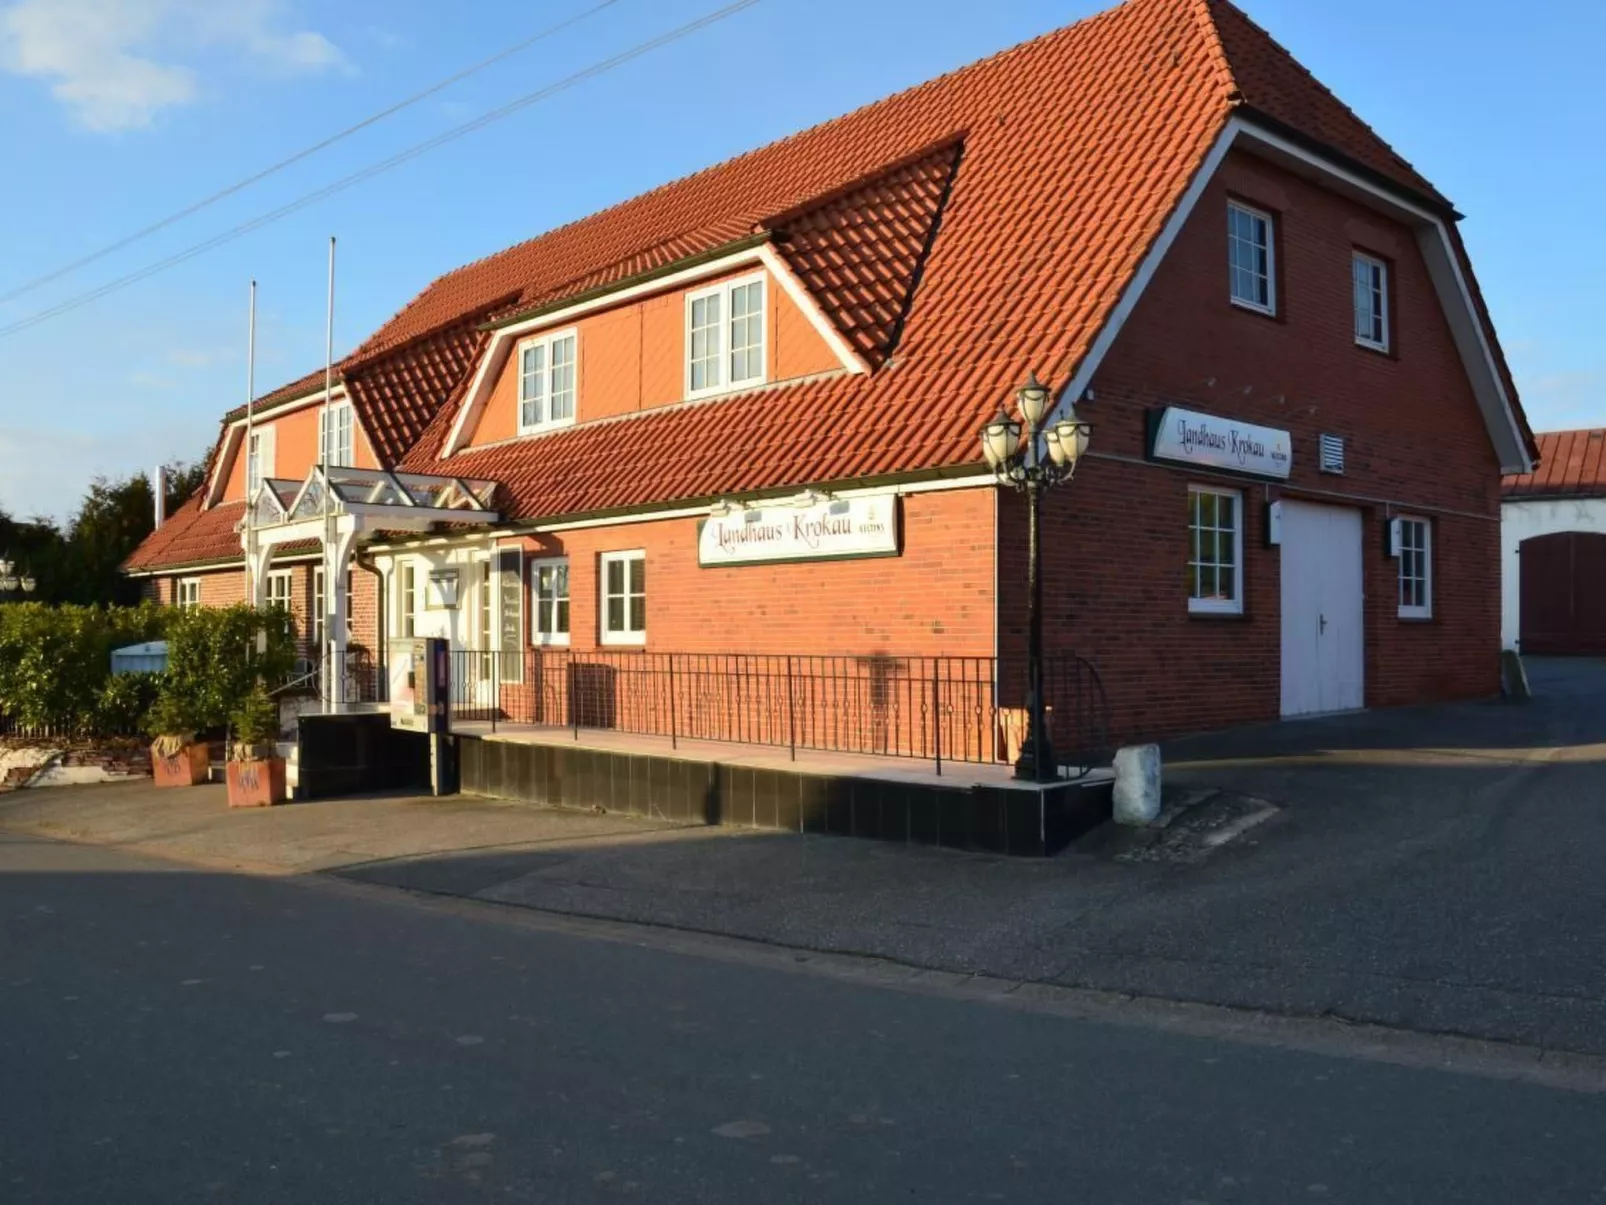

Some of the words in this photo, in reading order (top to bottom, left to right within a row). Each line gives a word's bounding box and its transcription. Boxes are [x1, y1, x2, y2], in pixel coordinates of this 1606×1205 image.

[1178, 419, 1226, 454] Landhaus
[1227, 427, 1265, 465] Krokau
[711, 519, 784, 555] Landhaus
[787, 513, 852, 549] Krokau
